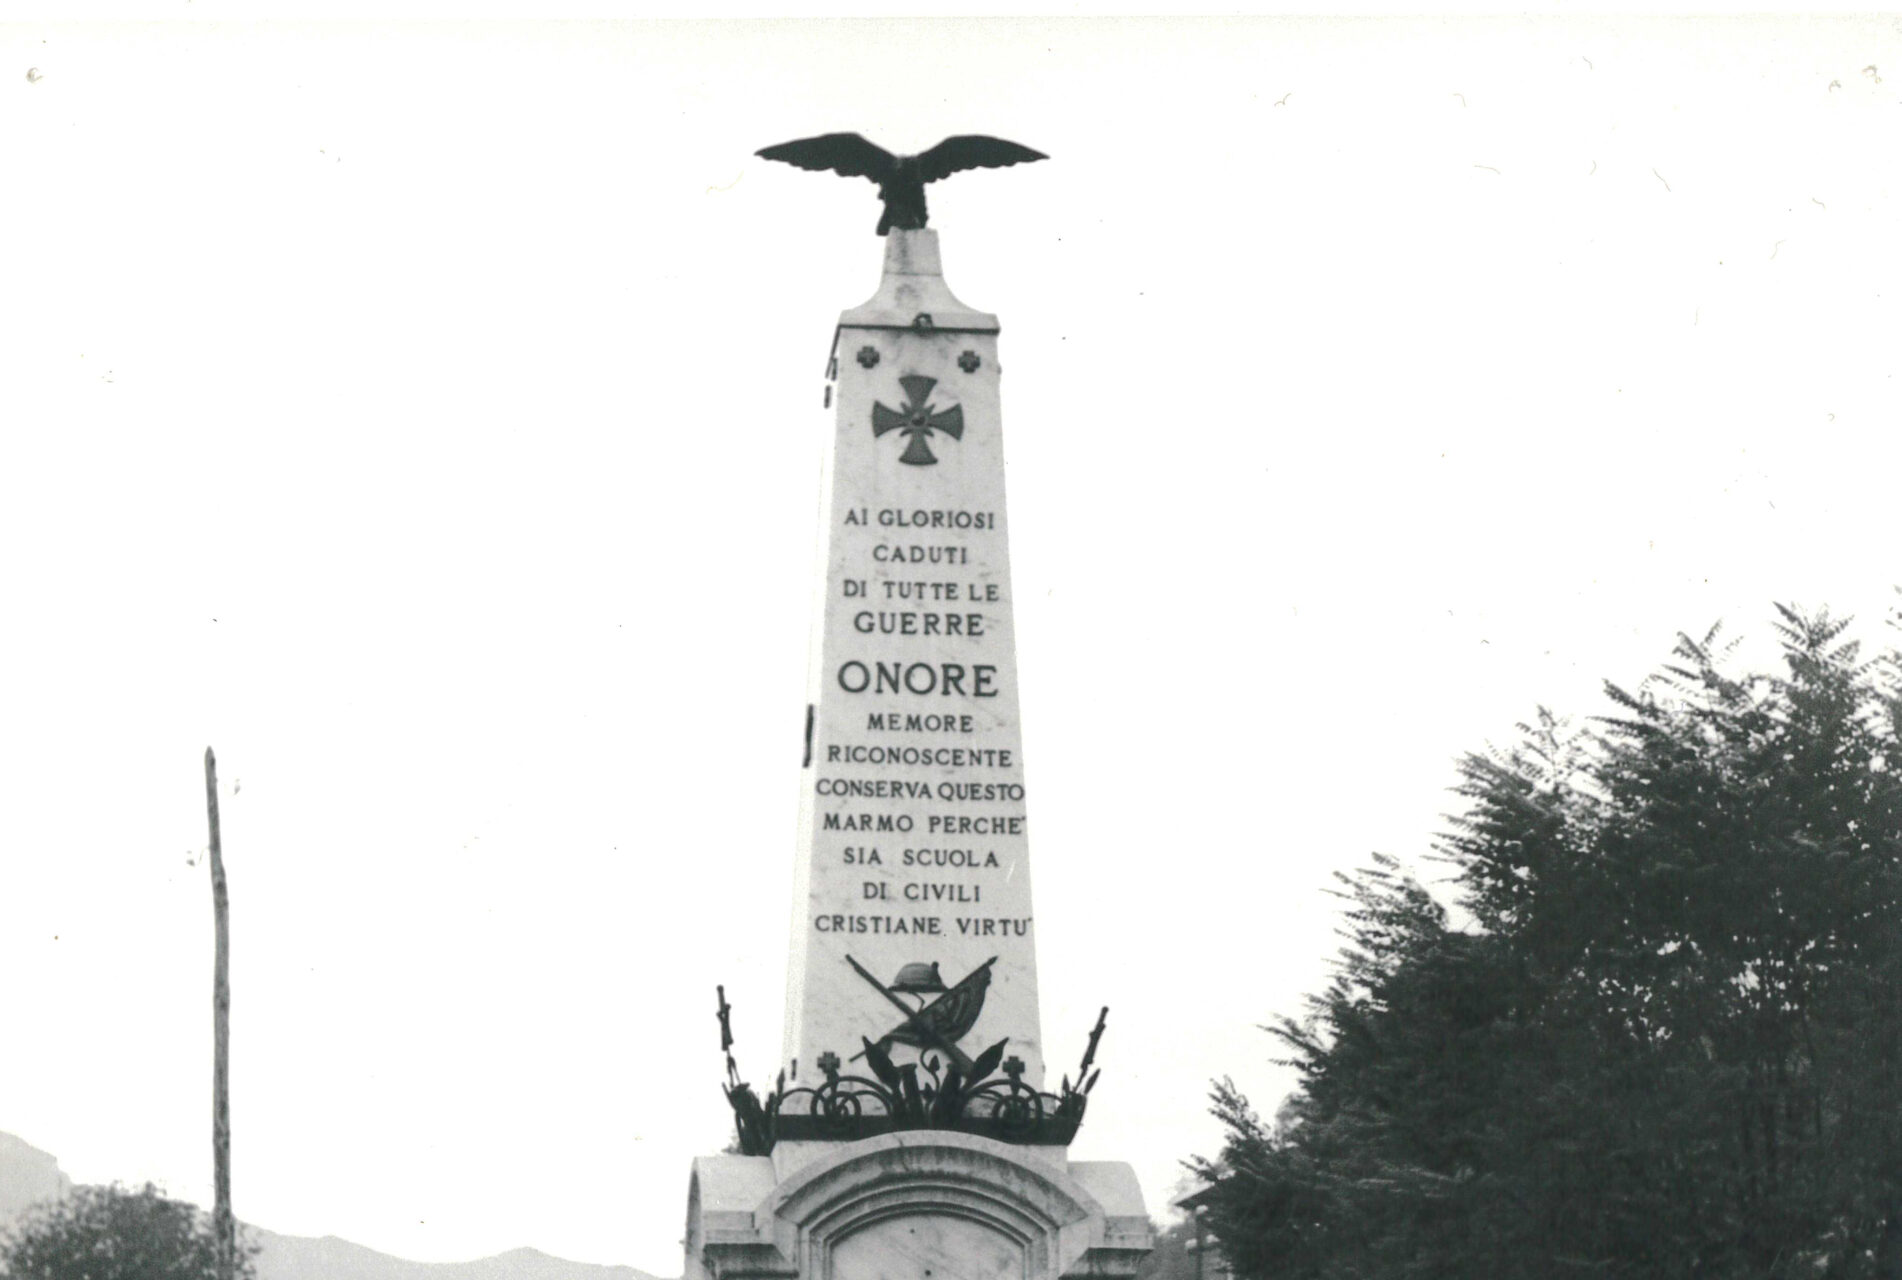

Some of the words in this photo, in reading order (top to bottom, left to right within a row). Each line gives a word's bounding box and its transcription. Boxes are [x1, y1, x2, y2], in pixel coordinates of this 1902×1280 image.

[844, 508, 868, 526] AI
[878, 509, 994, 529] GLORIOSI
[873, 545, 967, 564] CADUTI
[843, 580, 866, 598] DI
[883, 581, 959, 600] TUTTE
[968, 584, 999, 601] LE
[854, 611, 984, 636] GUERRE
[838, 660, 998, 697] ONORE
[867, 713, 974, 732] MEMORE
[828, 745, 1012, 767] RICONOSCENTE
[816, 779, 932, 799] CONSERVA
[937, 782, 1025, 801] QUESTO
[823, 813, 913, 832] MARMO
[843, 848, 882, 865] SIA
[903, 849, 999, 867] SCUOLA
[863, 882, 887, 900] DI
[904, 883, 980, 902] CIVILI
[815, 915, 941, 934] CRISTIANE
